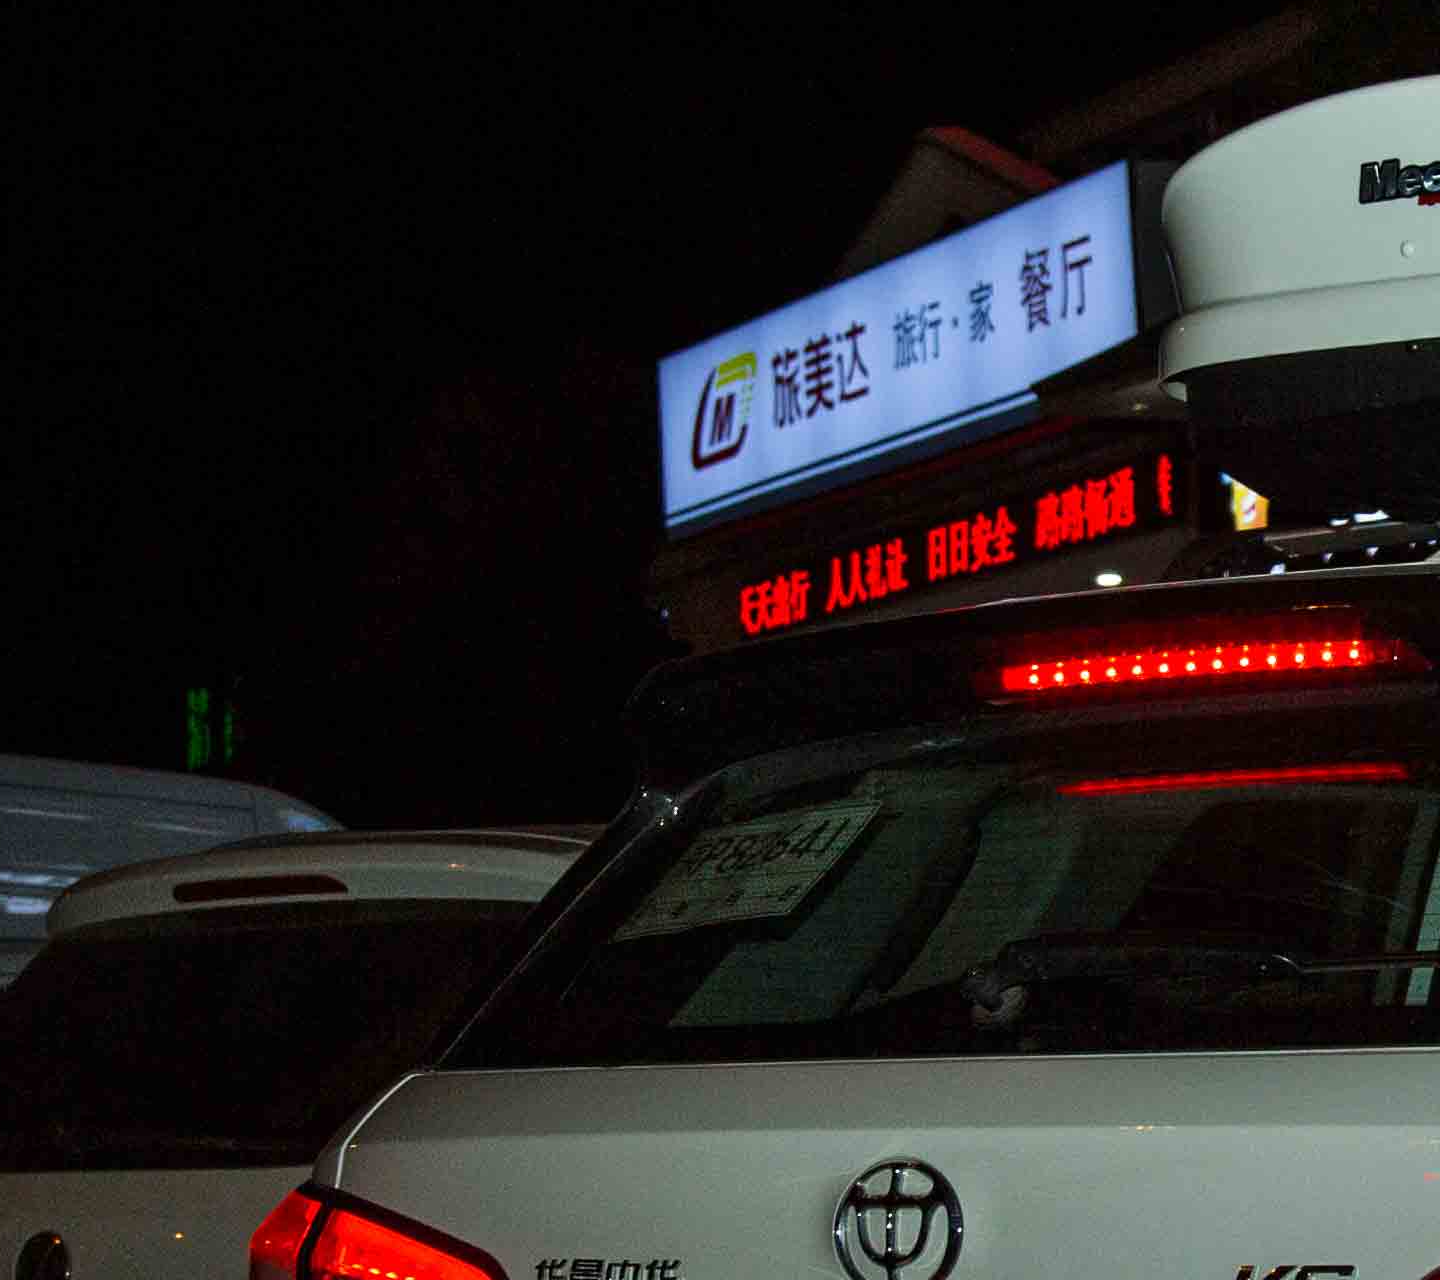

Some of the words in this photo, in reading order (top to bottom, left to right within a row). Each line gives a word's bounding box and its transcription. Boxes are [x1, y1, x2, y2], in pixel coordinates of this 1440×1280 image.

[770, 320, 870, 429] 旅美达
[1017, 233, 1094, 333] 餐厅
